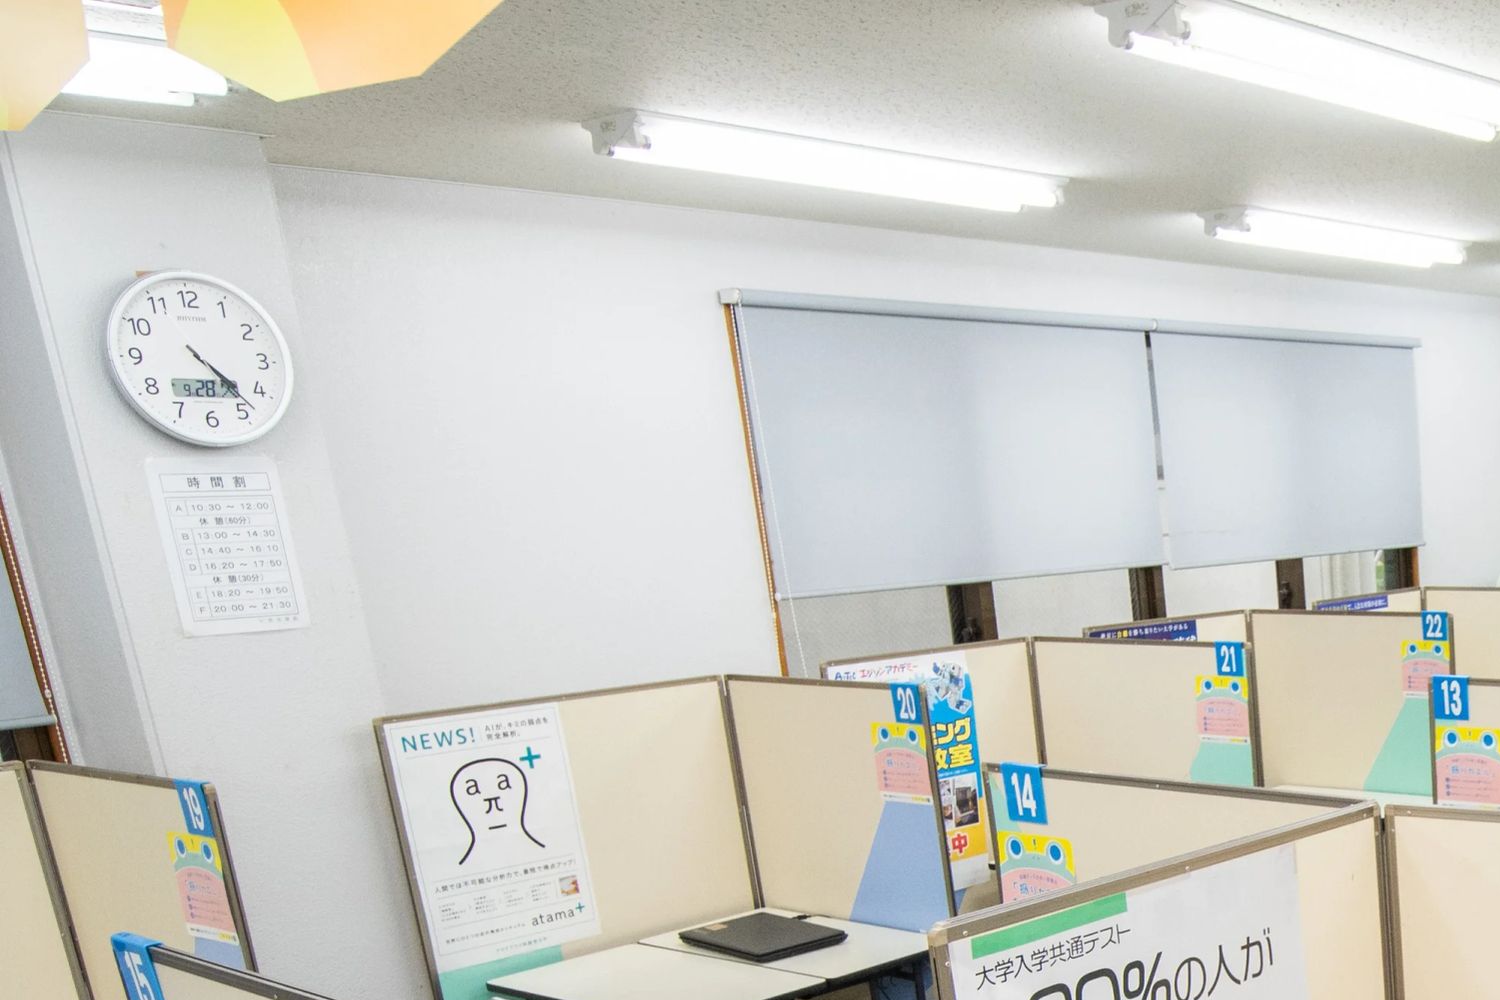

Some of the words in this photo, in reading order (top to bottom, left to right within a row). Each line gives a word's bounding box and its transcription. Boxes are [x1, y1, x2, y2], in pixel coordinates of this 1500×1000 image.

[147, 296, 167, 315] 11
[177, 290, 200, 309] 12
[217, 301, 226, 318] 1
[128, 317, 151, 336] 10
[240, 323, 254, 341] 2
[128, 347, 142, 365] 9
[256, 353, 269, 370] 3
[145, 377, 159, 395] 8
[253, 381, 266, 397] 4
[172, 401, 184, 418] 7
[236, 403, 249, 420] 5
[206, 411, 219, 428] 6
[187, 476, 246, 488] 時間割
[1426, 614, 1443, 638] 22
[1221, 645, 1236, 672] 21
[897, 687, 916, 720] 20
[1441, 680, 1462, 716] 13
[401, 727, 476, 752] NEWS!
[1011, 772, 1037, 817] 14
[182, 787, 204, 831] 19
[975, 924, 1131, 991] 大学入学共通テスト
